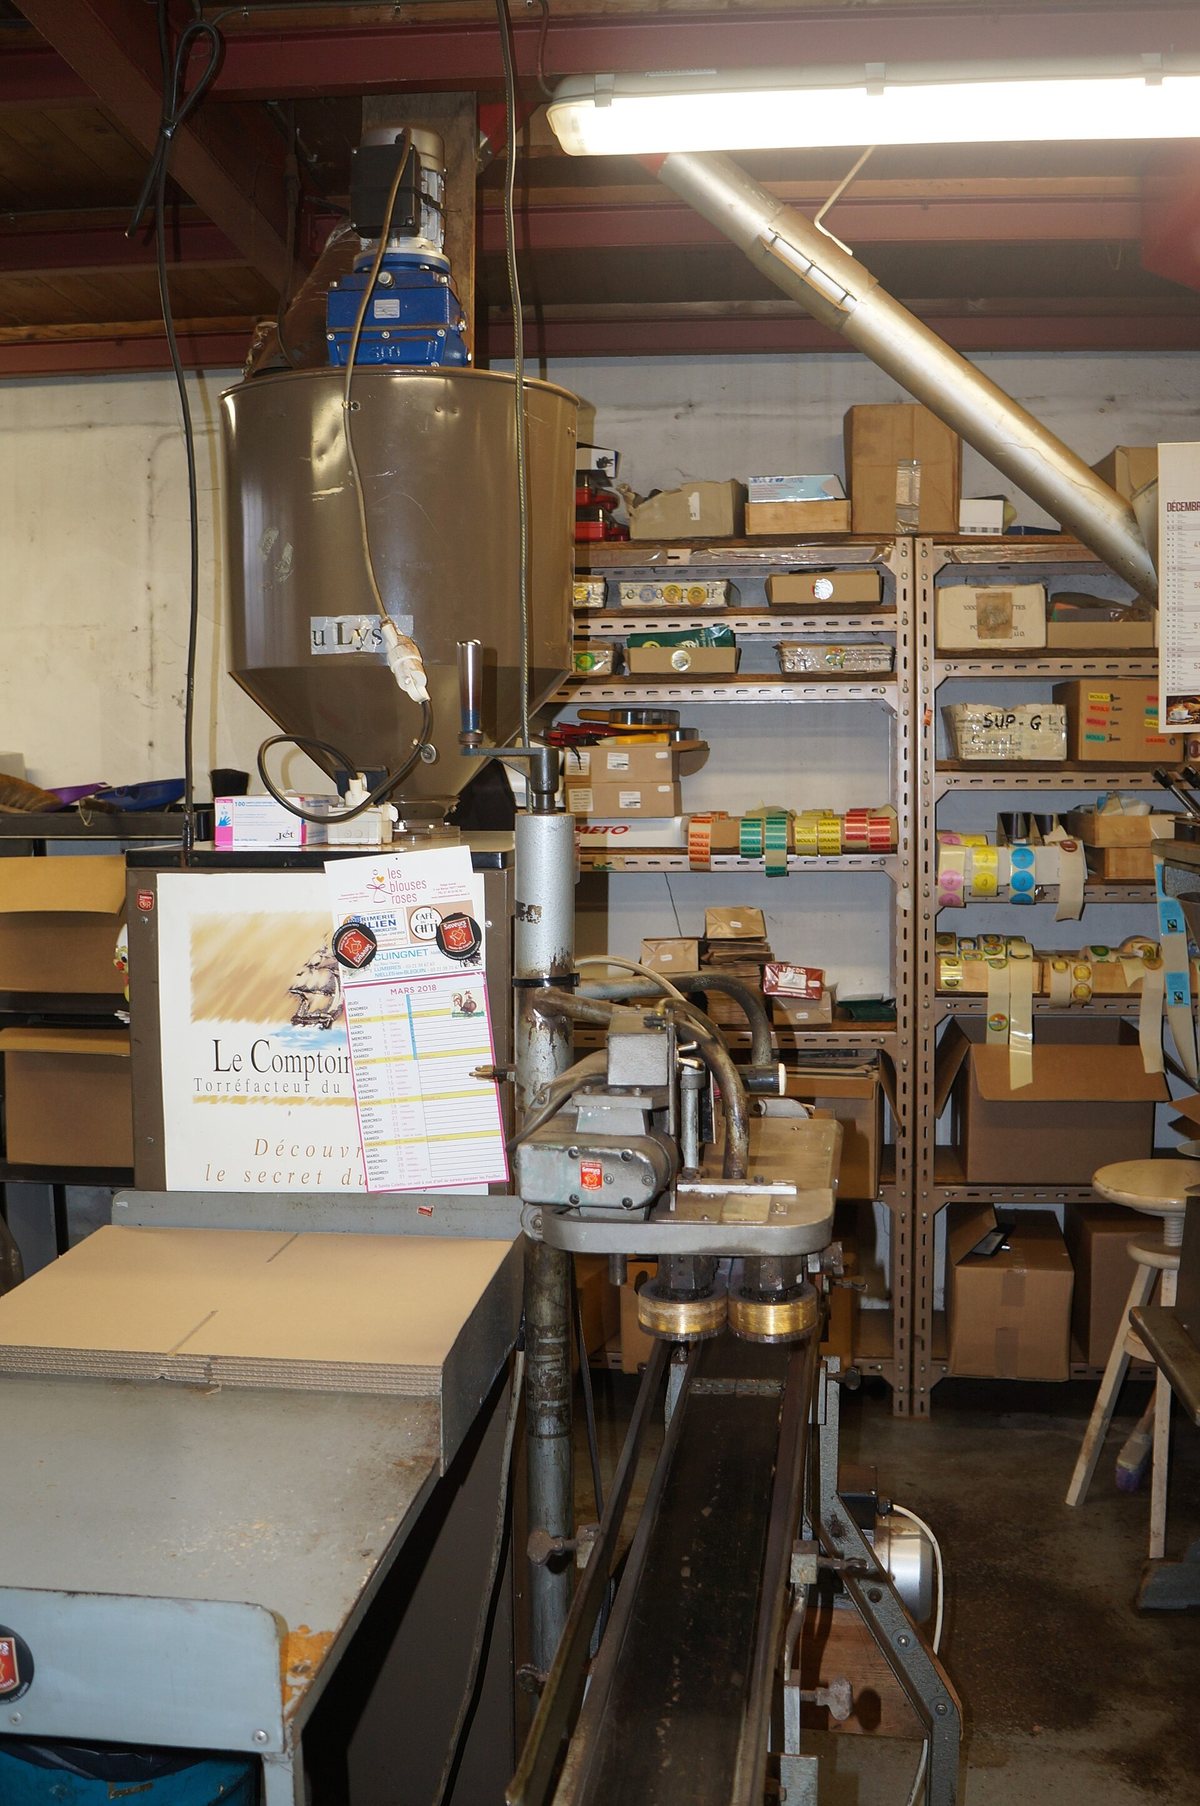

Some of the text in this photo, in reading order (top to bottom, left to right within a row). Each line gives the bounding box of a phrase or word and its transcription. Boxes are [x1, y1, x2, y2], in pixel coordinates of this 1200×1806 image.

[334, 622, 382, 650] Lys
[983, 713, 1016, 729] SUP
[1030, 715, 1041, 731] G
[387, 868, 402, 880] les
[389, 880, 427, 892] blouses
[391, 893, 418, 905] roses
[390, 984, 437, 996] MARS 2018
[212, 1039, 350, 1081] Le Comptoir
[194, 1077, 340, 1094] Torréfacteur du
[205, 1163, 226, 1182] le
[243, 1167, 323, 1184] secret
